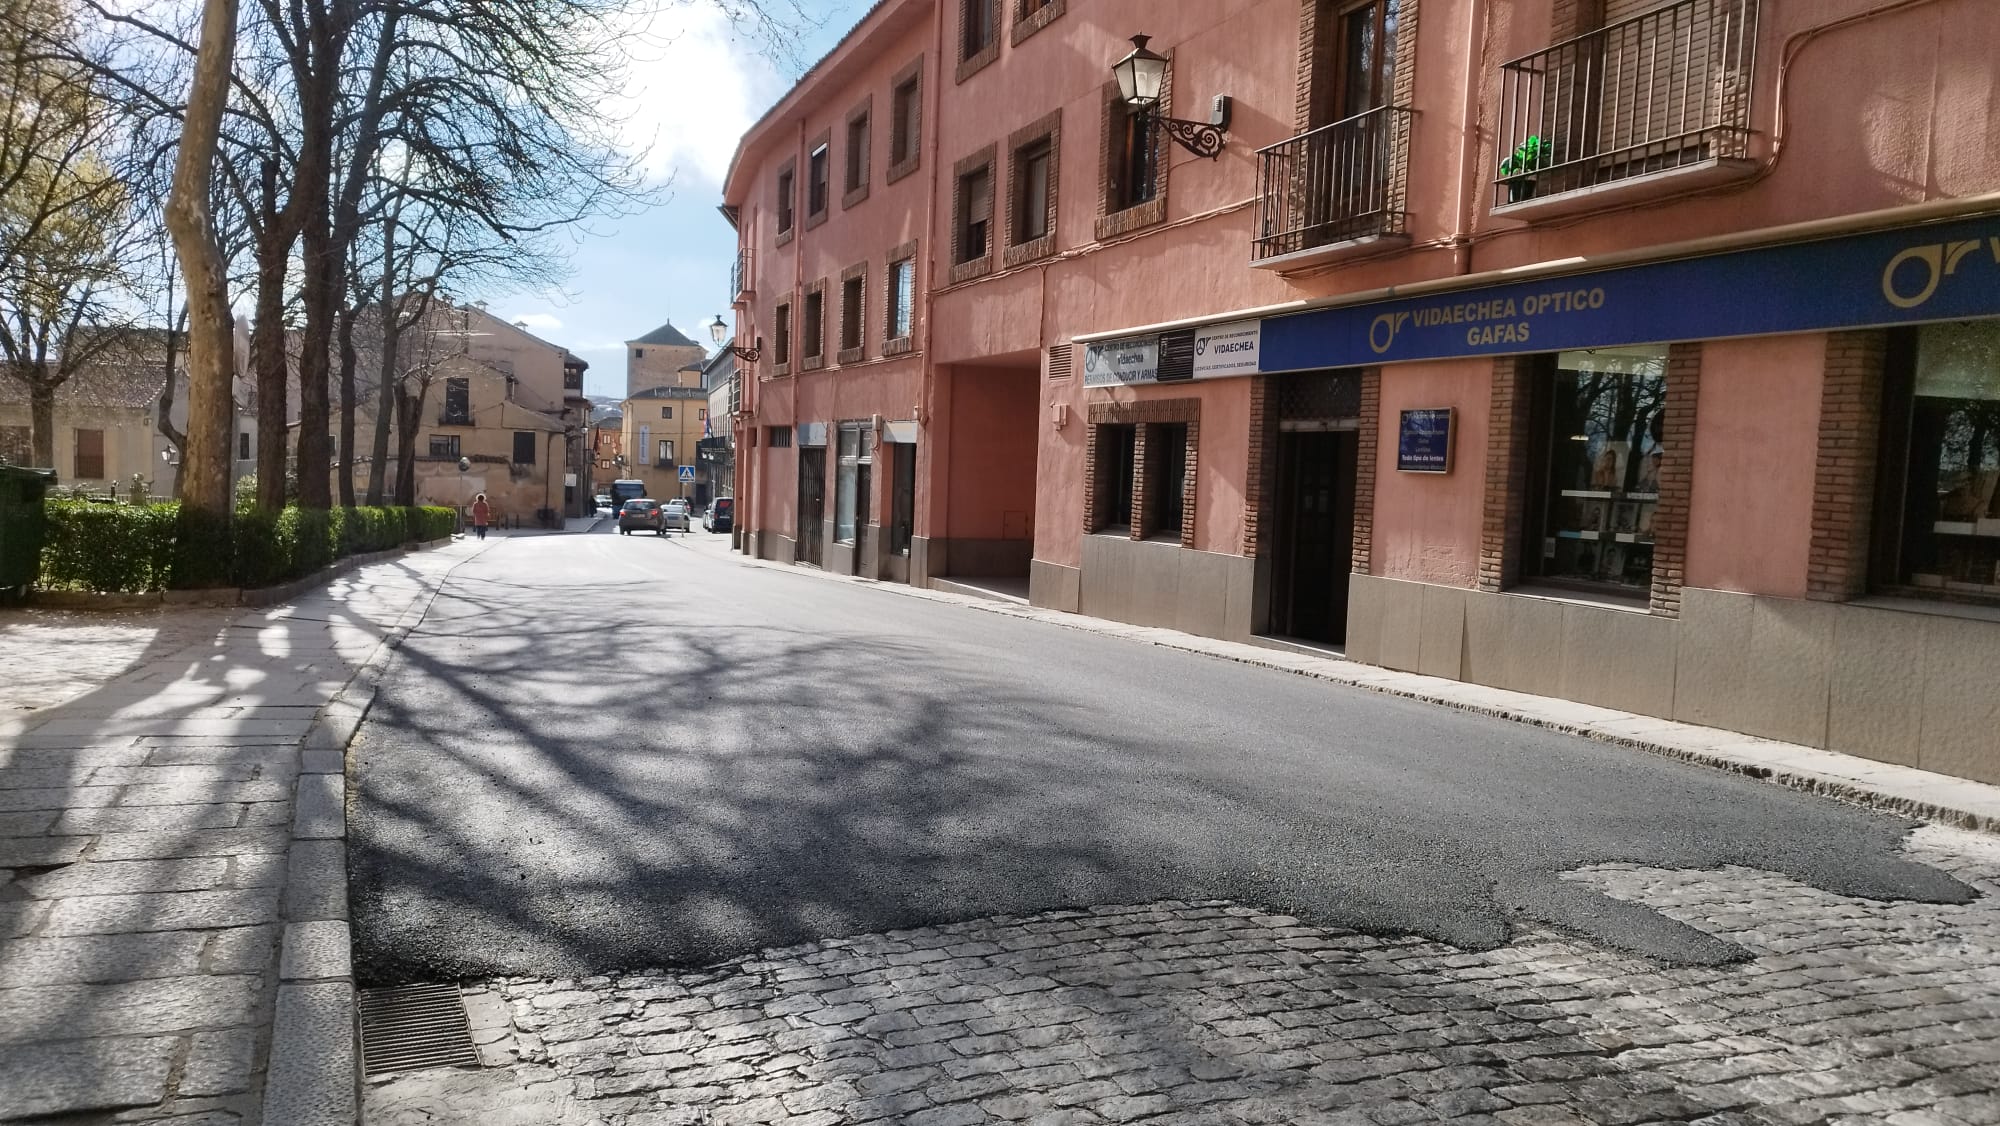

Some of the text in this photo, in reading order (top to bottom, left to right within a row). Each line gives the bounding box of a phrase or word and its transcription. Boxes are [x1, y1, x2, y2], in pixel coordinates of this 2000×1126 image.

[1412, 288, 1606, 328] VIDAECHEA OPTICO
[1467, 322, 1530, 346] GAFAS
[1214, 340, 1254, 355] VIDAECHEA
